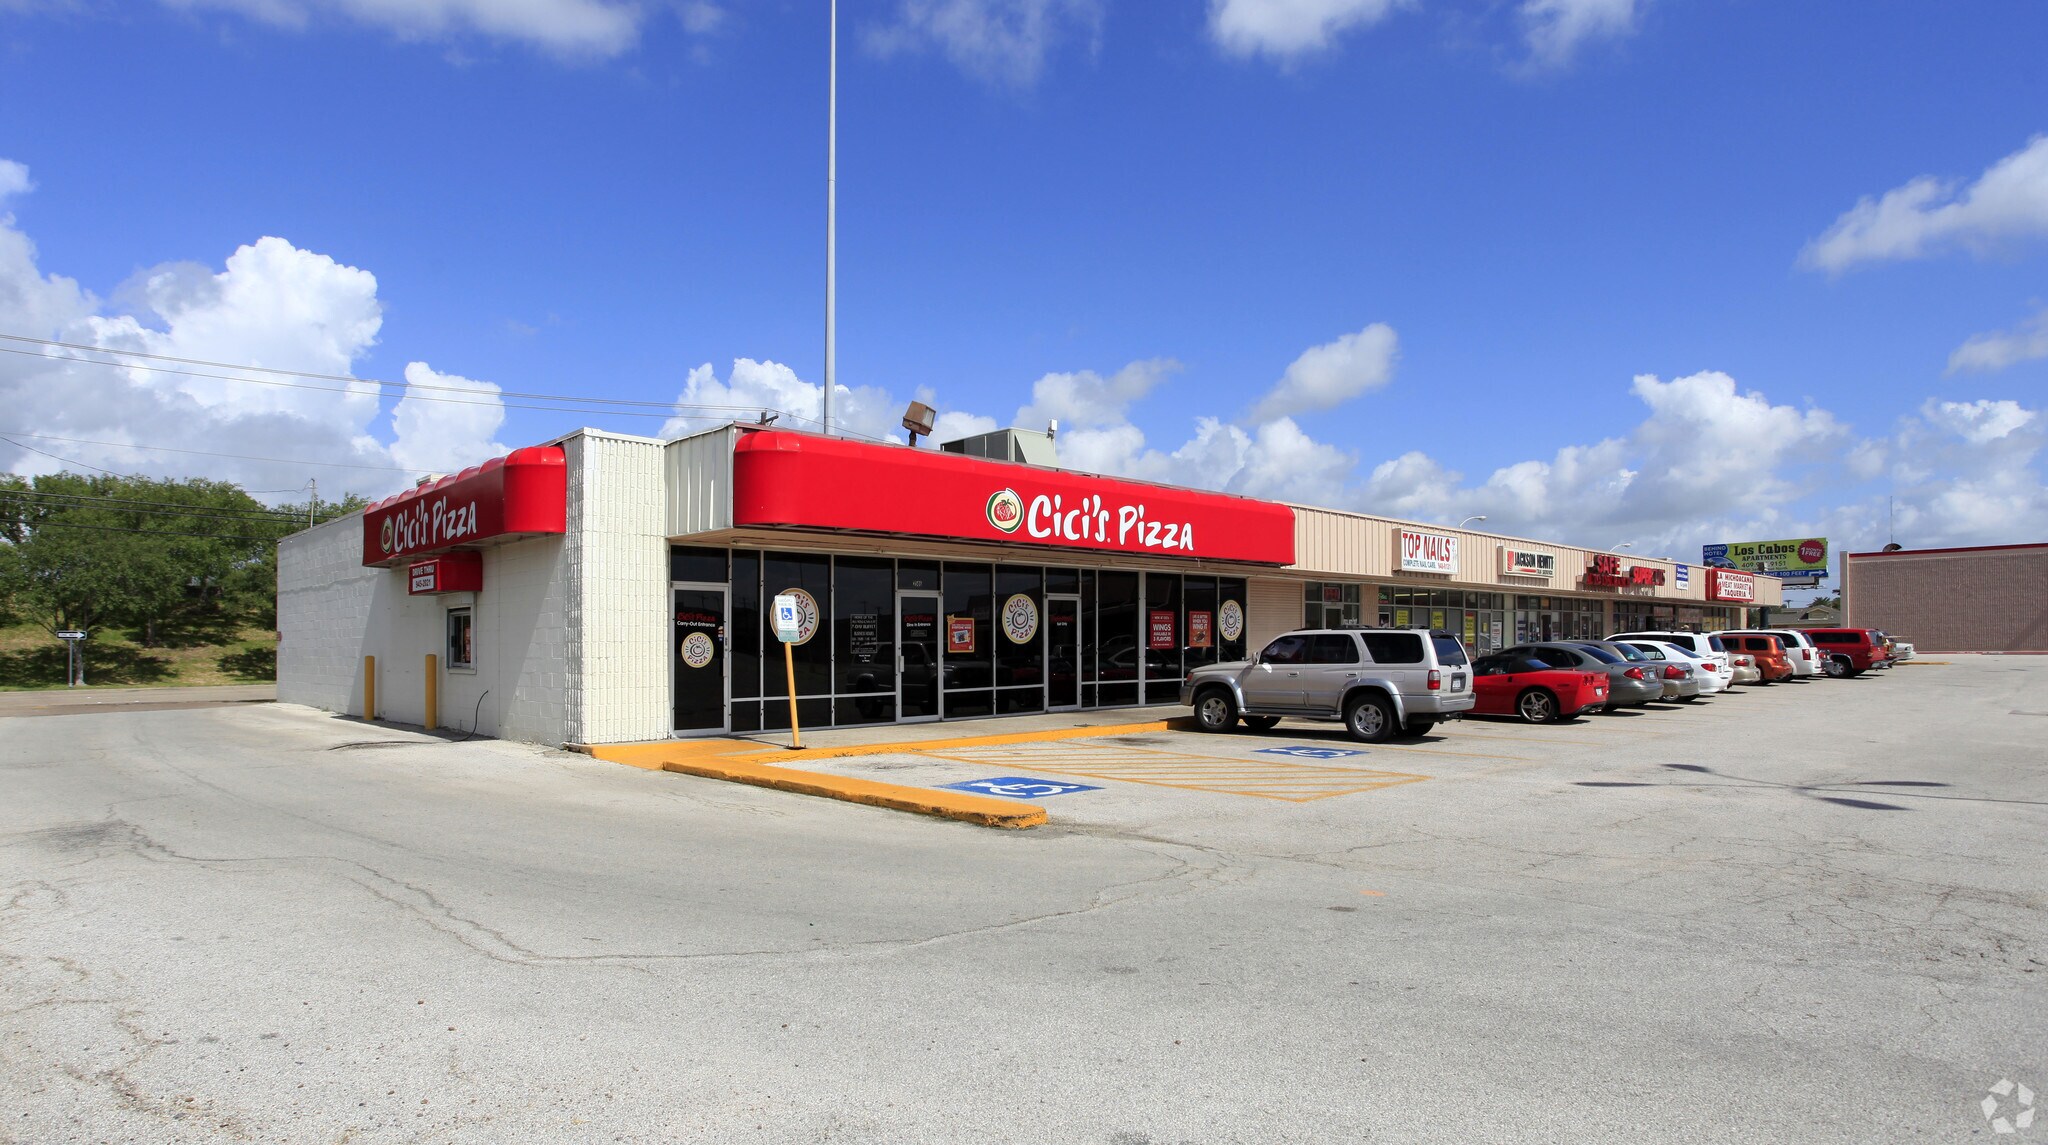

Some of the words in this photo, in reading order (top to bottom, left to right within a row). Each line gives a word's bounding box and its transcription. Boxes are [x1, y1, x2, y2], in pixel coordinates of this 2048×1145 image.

[1027, 494, 1110, 543] Cici's
[1402, 533, 1421, 559] TOP
[1423, 536, 1450, 562] NAILS
[1734, 546, 1754, 556] Los
[1758, 544, 1795, 554] Cabos
[1514, 551, 1535, 567] JACKSON
[1537, 554, 1553, 569] HEWITT
[1595, 554, 1620, 575] SAFE
[412, 566, 423, 577] DRIVE
[1733, 582, 1749, 590] MARKET
[1724, 589, 1746, 597] TAQUERIA
[1152, 623, 1171, 631] WINGS
